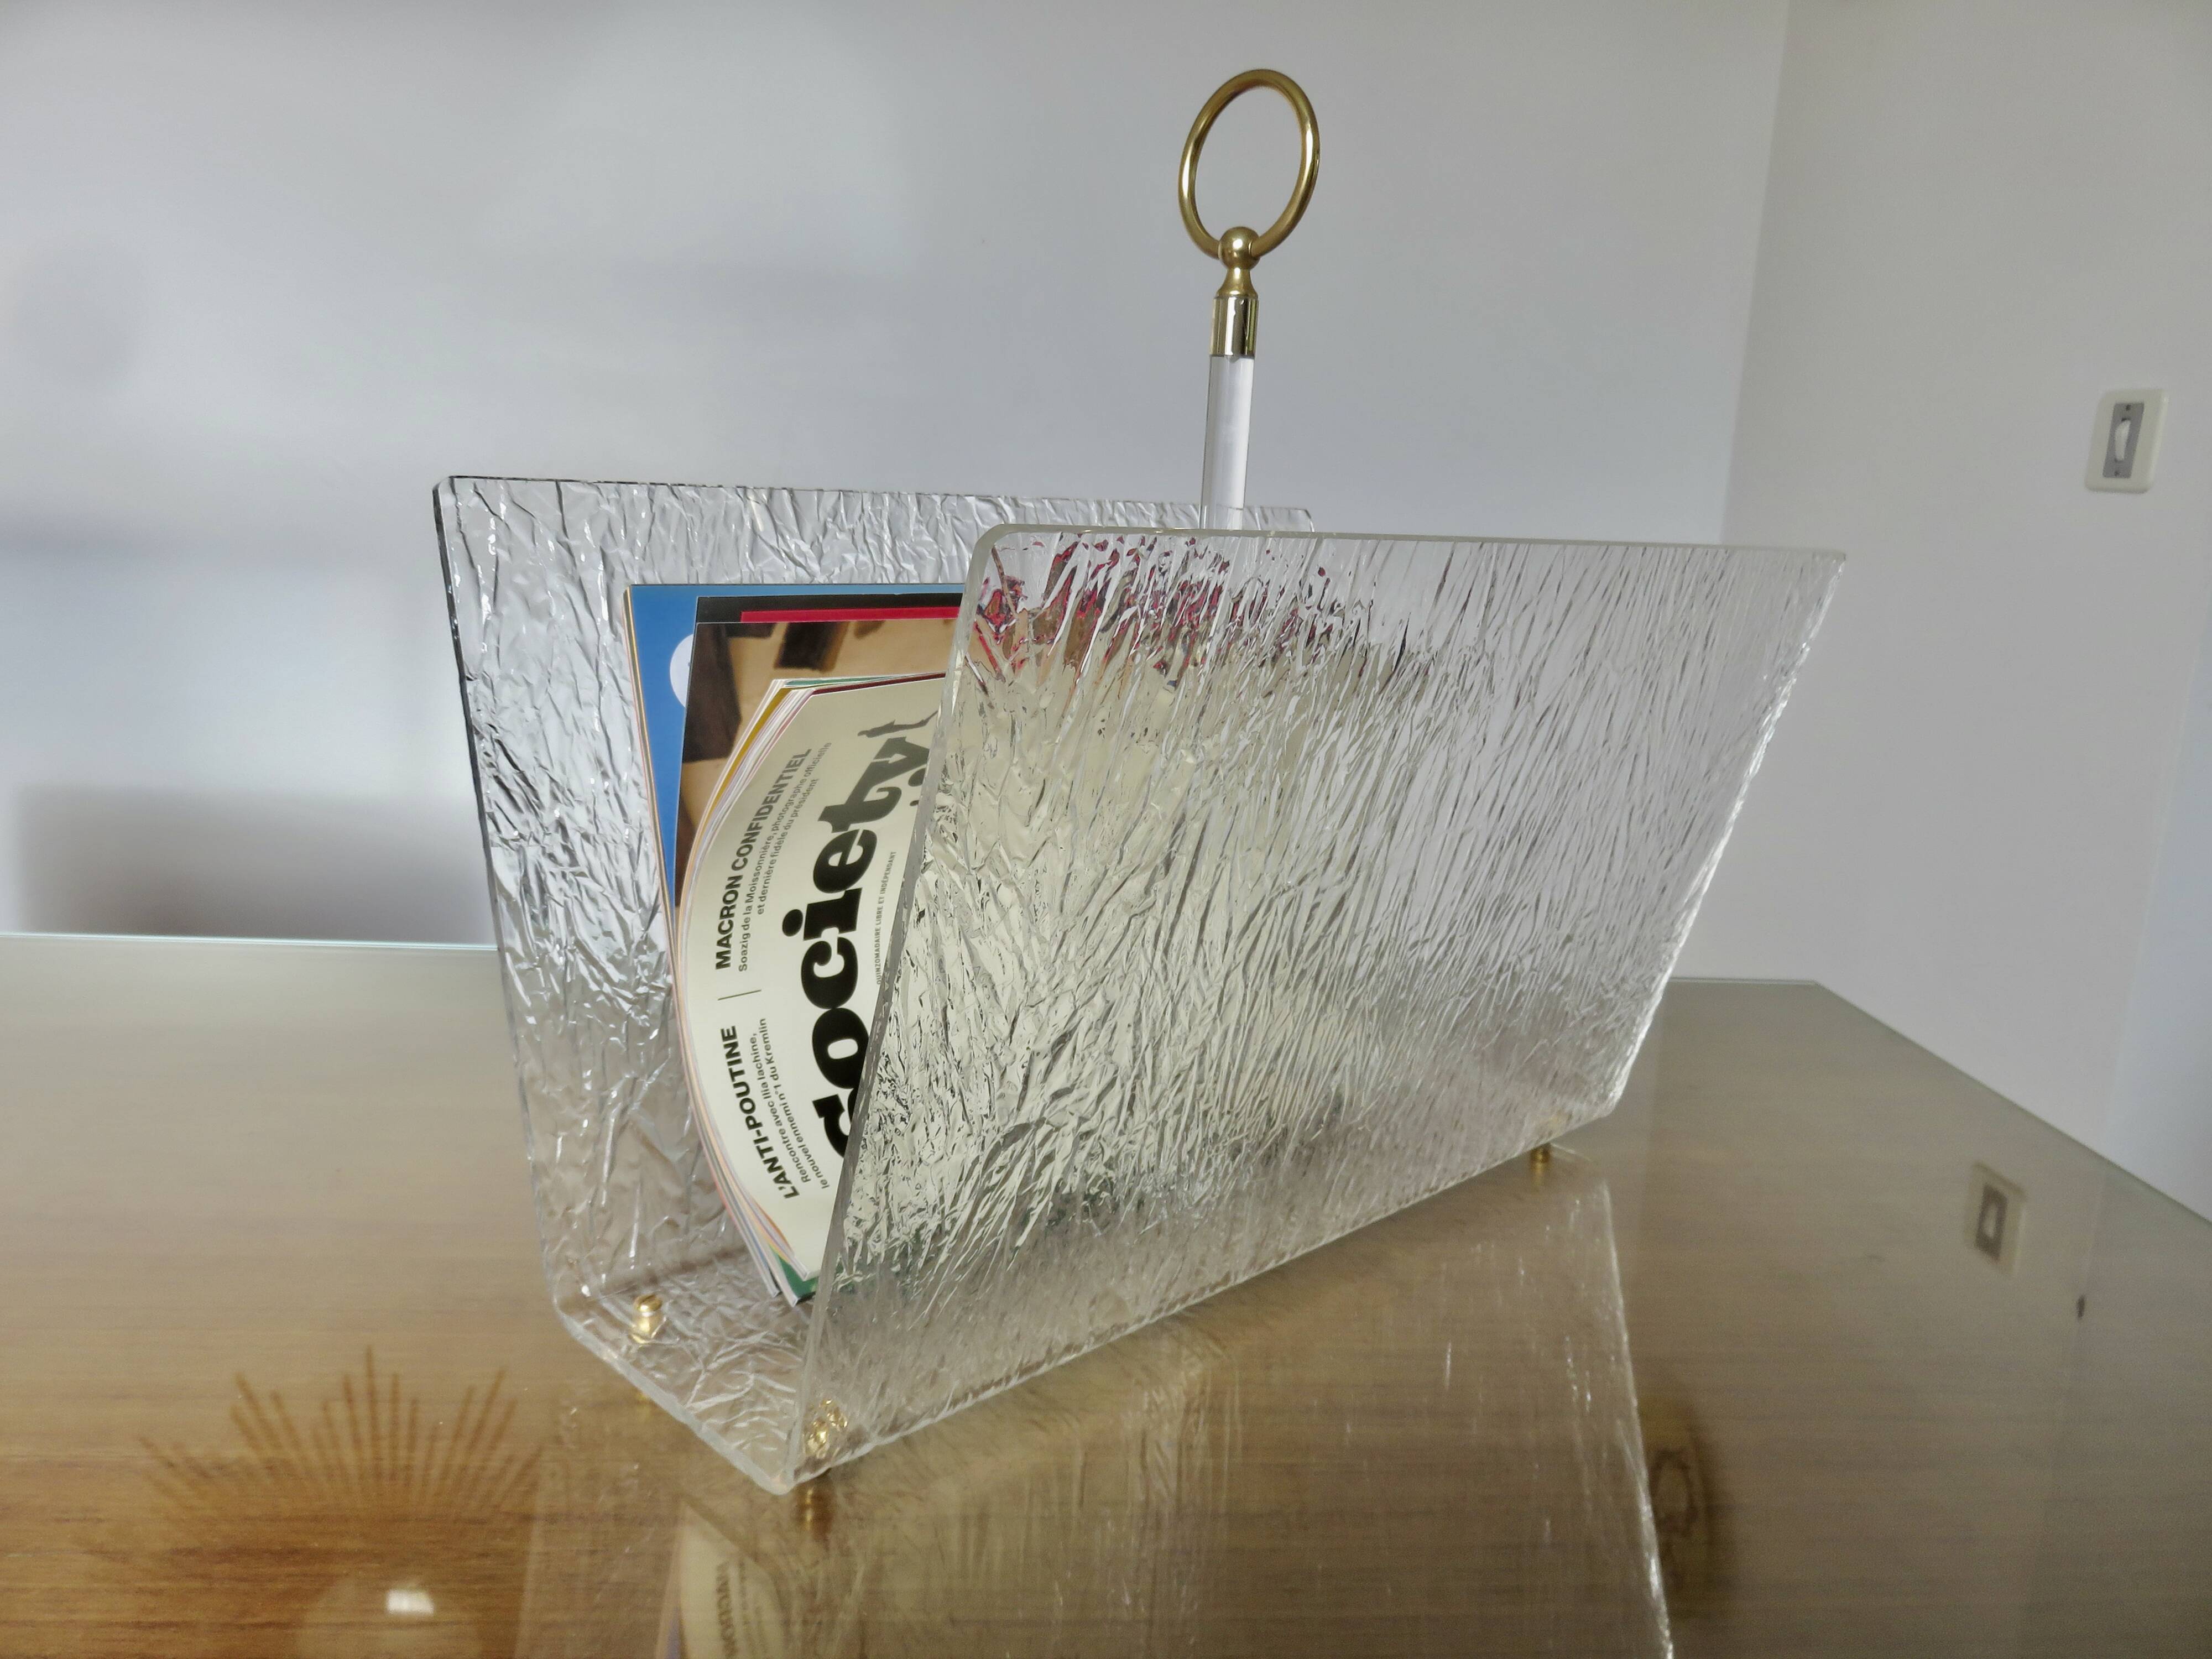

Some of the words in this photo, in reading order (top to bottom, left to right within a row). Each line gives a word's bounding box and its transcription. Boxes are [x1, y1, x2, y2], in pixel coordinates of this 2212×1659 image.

[804, 742, 832, 778] officielle
[771, 778, 807, 832] photographe
[791, 778, 819, 818] président
[784, 818, 795, 831] du
[716, 875, 743, 969] MACRON
[731, 748, 812, 871] CONFIDENTIEL
[770, 831, 788, 858] fidèle
[745, 832, 777, 904] Moissonnière,
[758, 858, 776, 902] dernière
[880, 851, 897, 895] INDÉPENDANT
[743, 905, 753, 915] la
[757, 904, 765, 915] et
[878, 896, 885, 904] ET
[742, 917, 750, 931] de
[739, 933, 751, 972] Soazig
[873, 926, 881, 985] QUINZOMADAIRE
[759, 1018, 775, 1065] Kremlin
[770, 1066, 779, 1081] du
[721, 1025, 800, 1199] L'ANTI-POUTINE
[768, 1100, 782, 1126] avec
[779, 1102, 804, 1144] ennemi
[779, 1128, 811, 1183] Rencontre
[798, 1144, 823, 1178] nouvel
[820, 1178, 830, 1189] le
